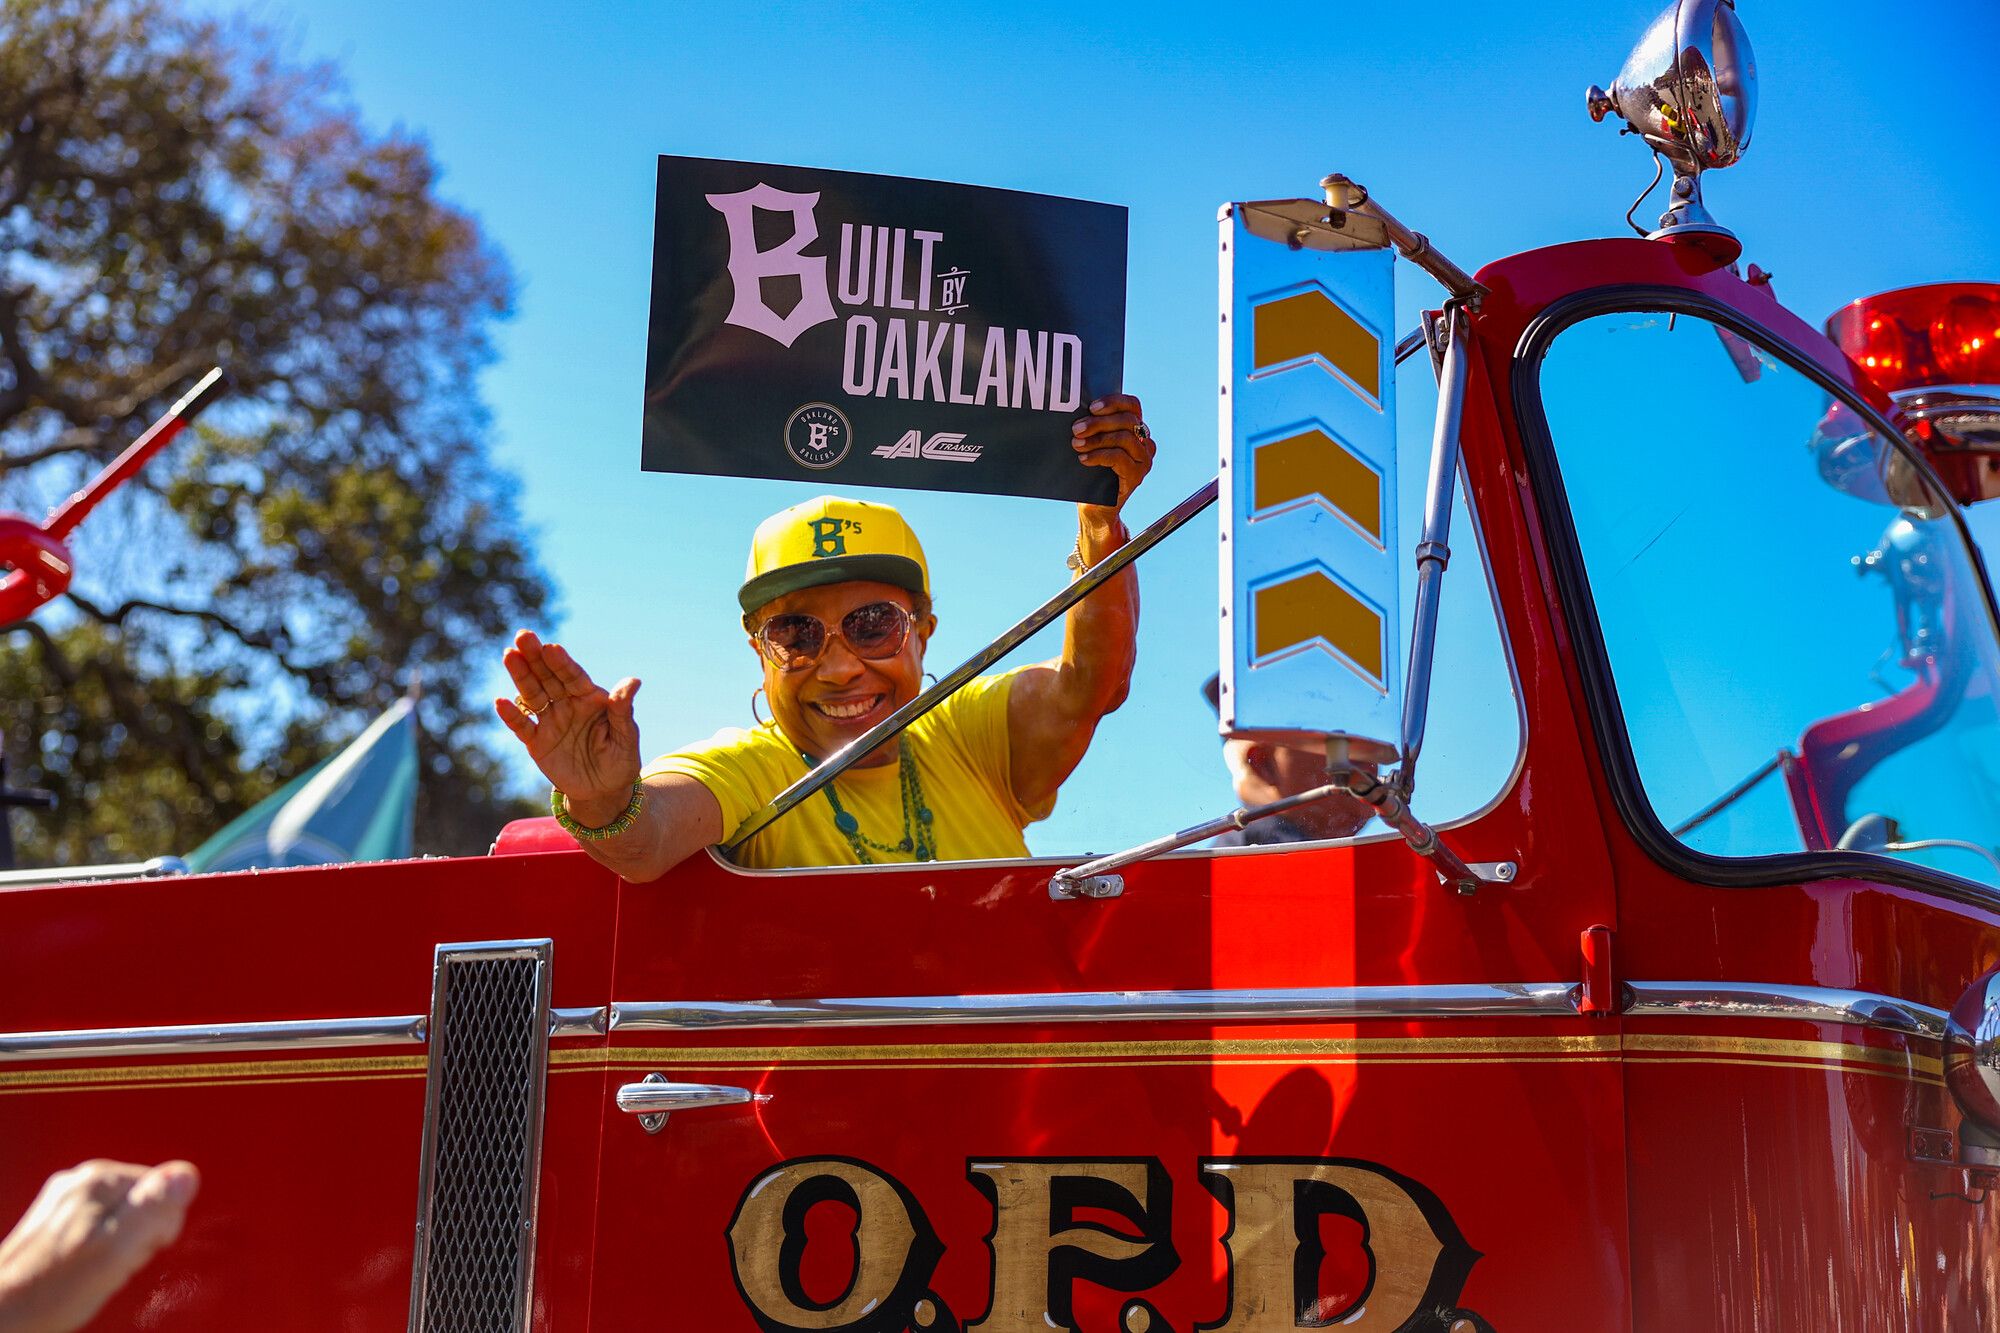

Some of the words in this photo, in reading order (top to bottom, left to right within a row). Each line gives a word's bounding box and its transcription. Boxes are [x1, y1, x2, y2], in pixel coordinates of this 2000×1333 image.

[705, 182, 943, 348] BUILT
[942, 276, 966, 307] BY
[842, 315, 1083, 413] OAKLAND
[801, 411, 838, 425] OAKLAND
[799, 447, 835, 462] BALLERS
[871, 430, 982, 463] AC
[939, 443, 984, 453] TRANSIT
